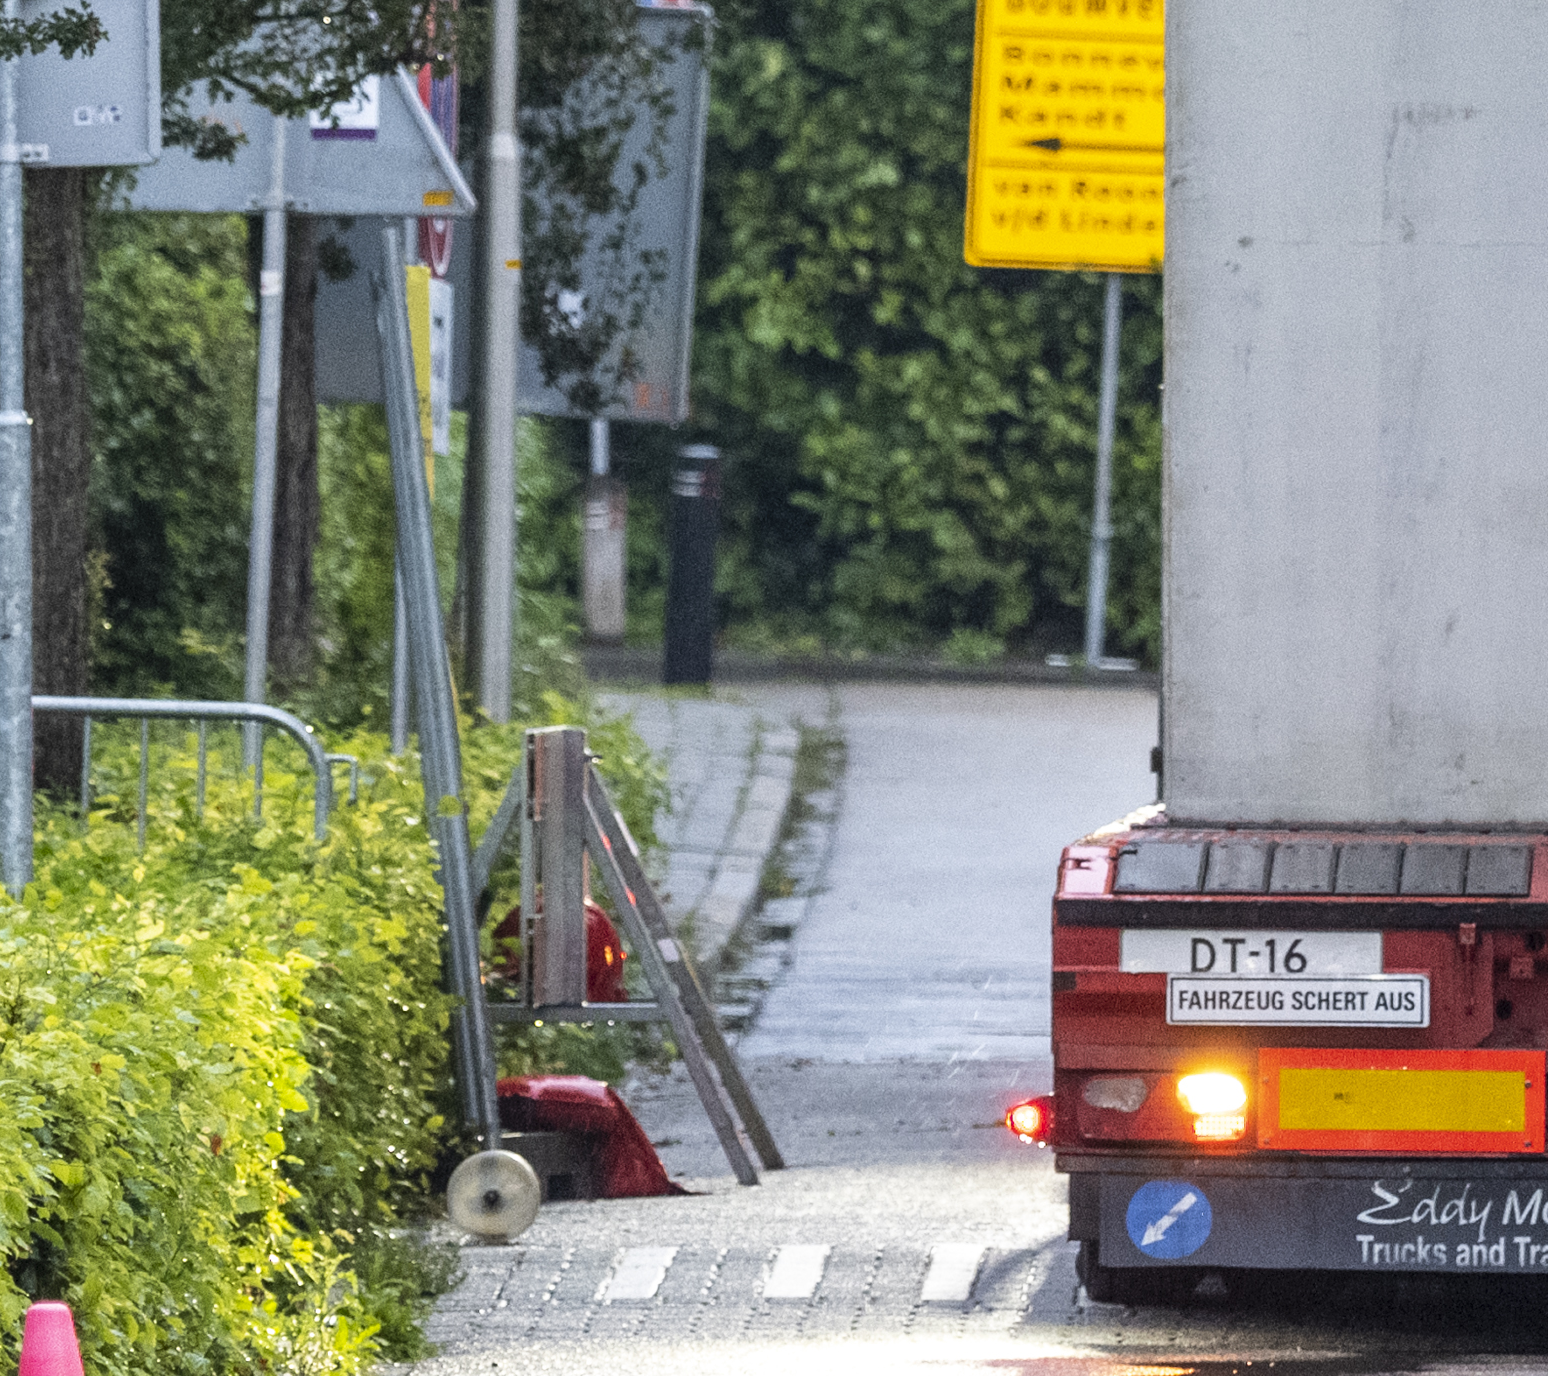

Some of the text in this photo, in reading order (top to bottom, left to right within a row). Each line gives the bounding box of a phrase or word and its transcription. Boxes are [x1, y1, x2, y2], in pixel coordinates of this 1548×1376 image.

[1190, 937, 1308, 974] DT-16
[1178, 989, 1415, 1012] FAHRZEUG SCHERT AUS
[1356, 1179, 1493, 1242] Eddy
[1356, 1234, 1447, 1265] Trucks
[1455, 1236, 1505, 1267] and
